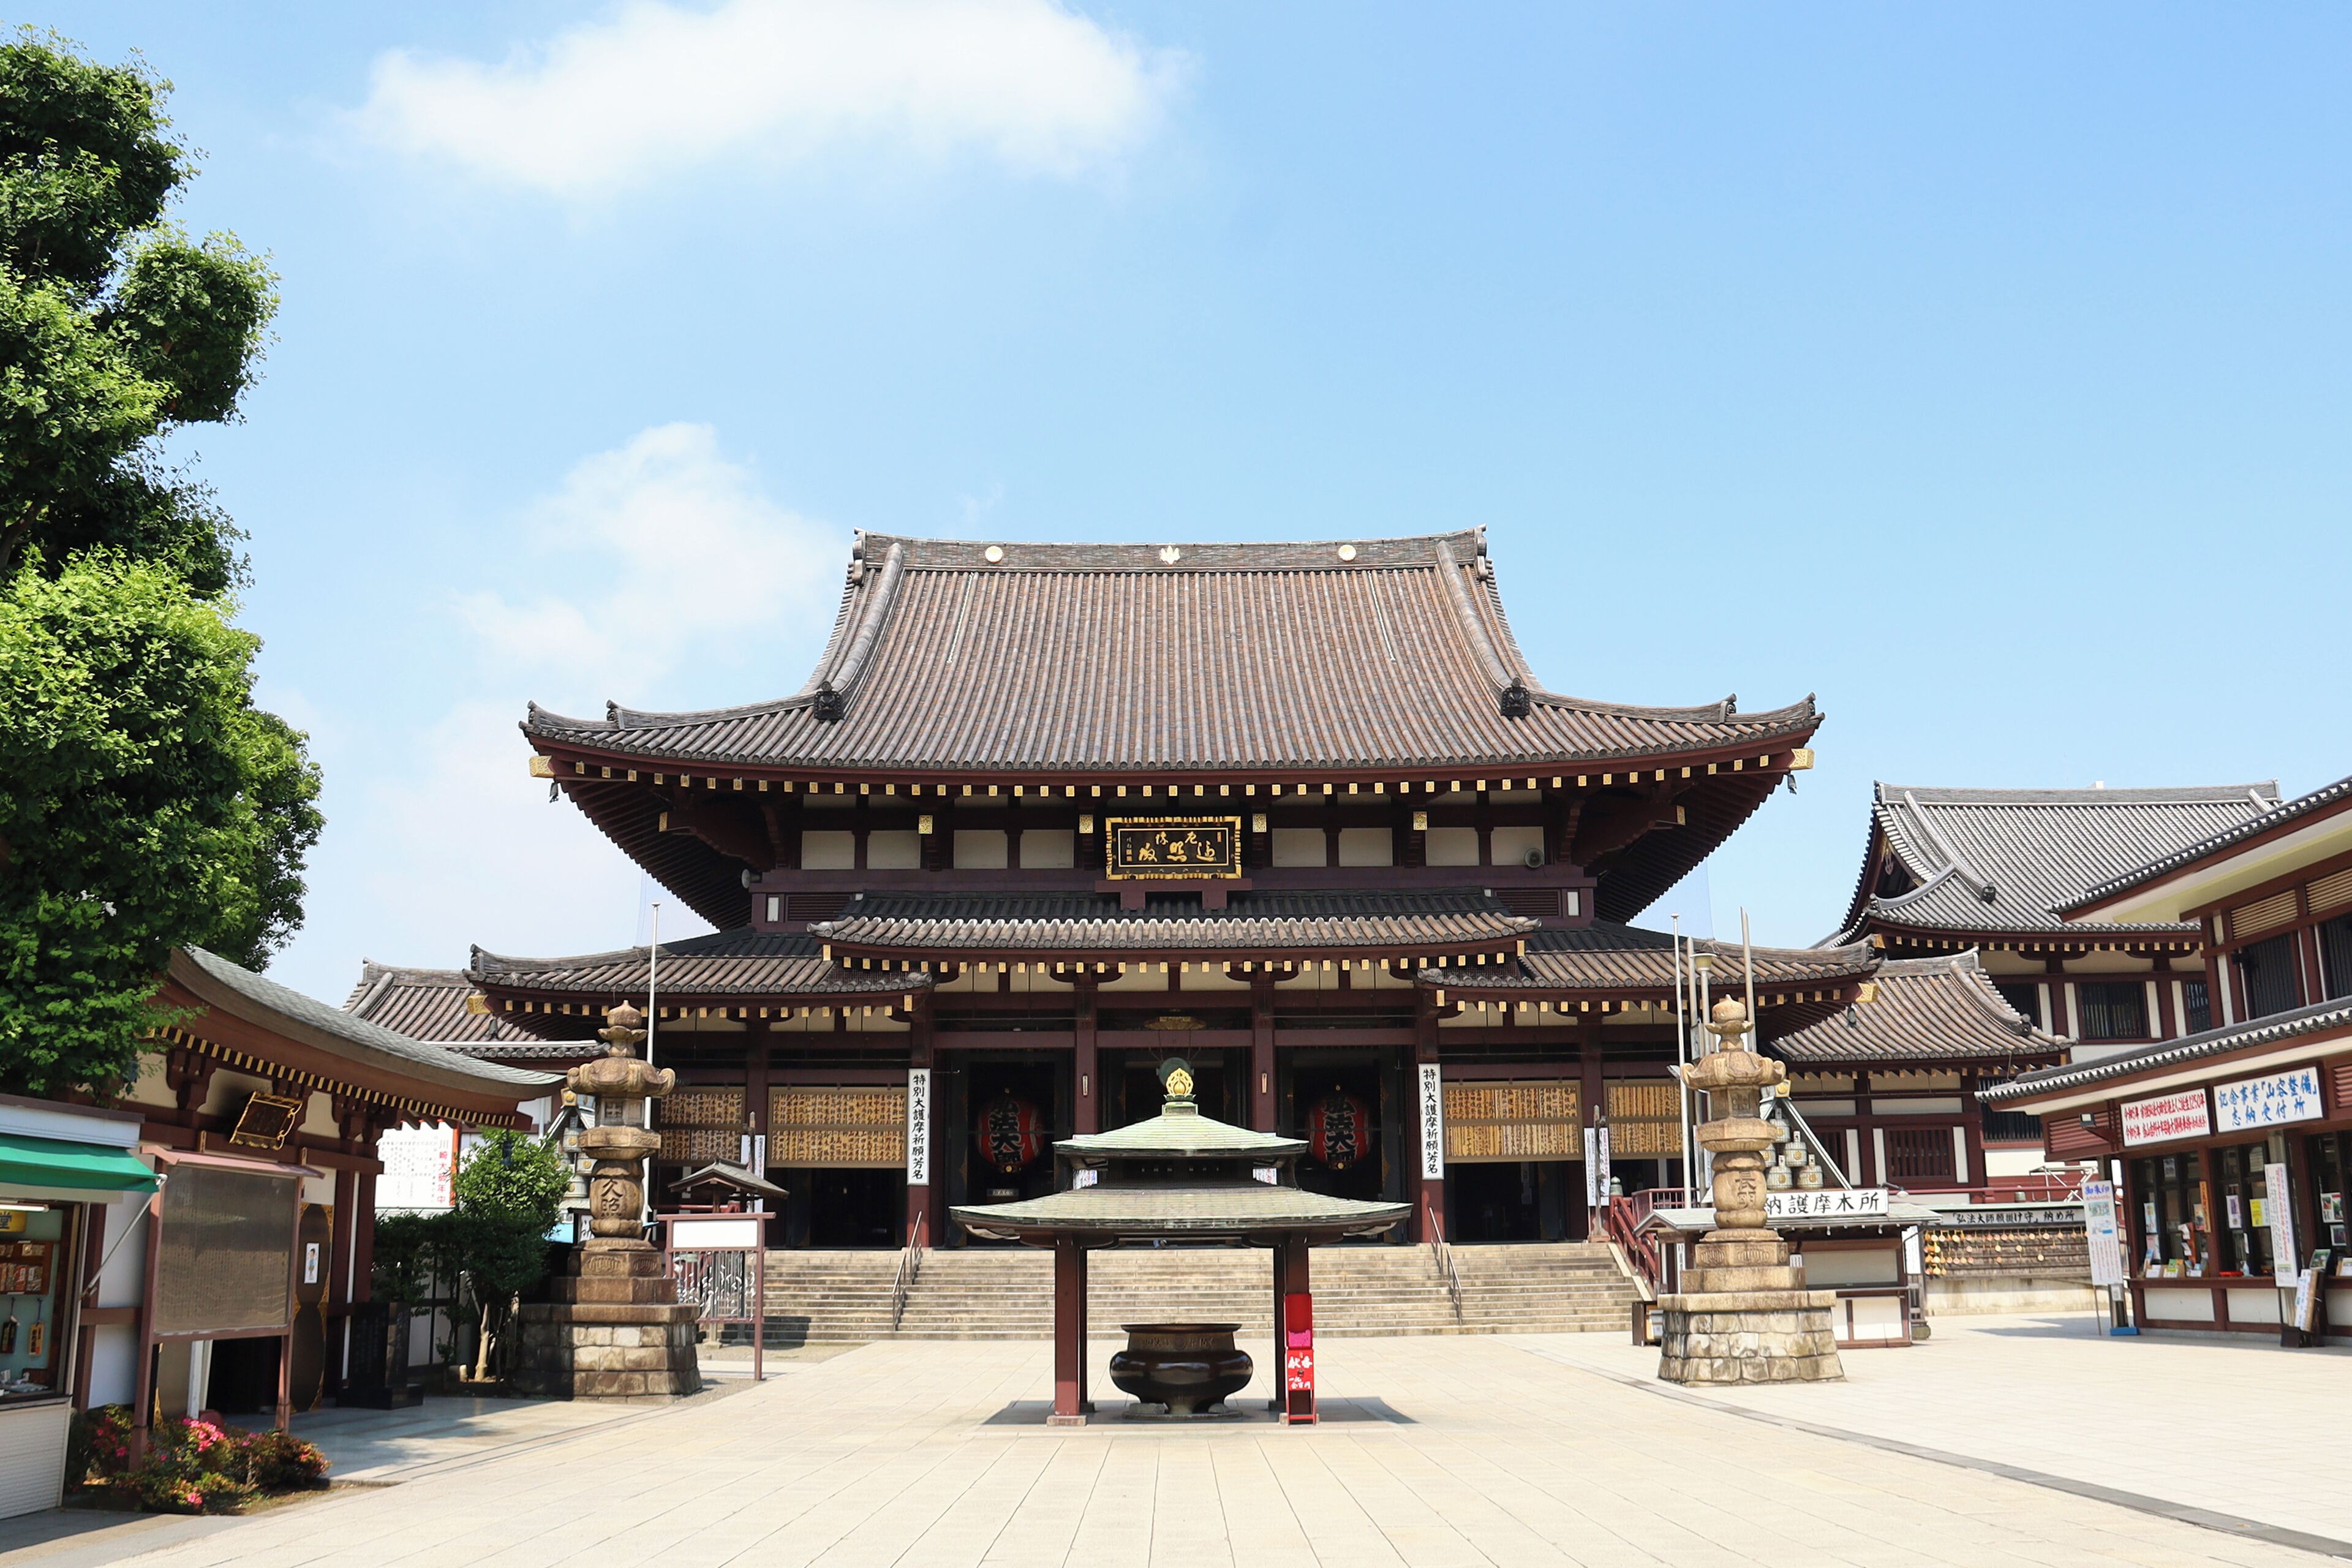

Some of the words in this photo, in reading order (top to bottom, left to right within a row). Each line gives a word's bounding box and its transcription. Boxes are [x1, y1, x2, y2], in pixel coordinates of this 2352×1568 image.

[911, 1074, 926, 1180] 特別大護摩祈願芳名
[1423, 1069, 1438, 1174] 特別大護摩祈願芳名
[2232, 1096, 2305, 1126] 志納受付所
[600, 1178, 624, 1218] 久照
[1764, 1193, 1879, 1215] 納護摩木所
